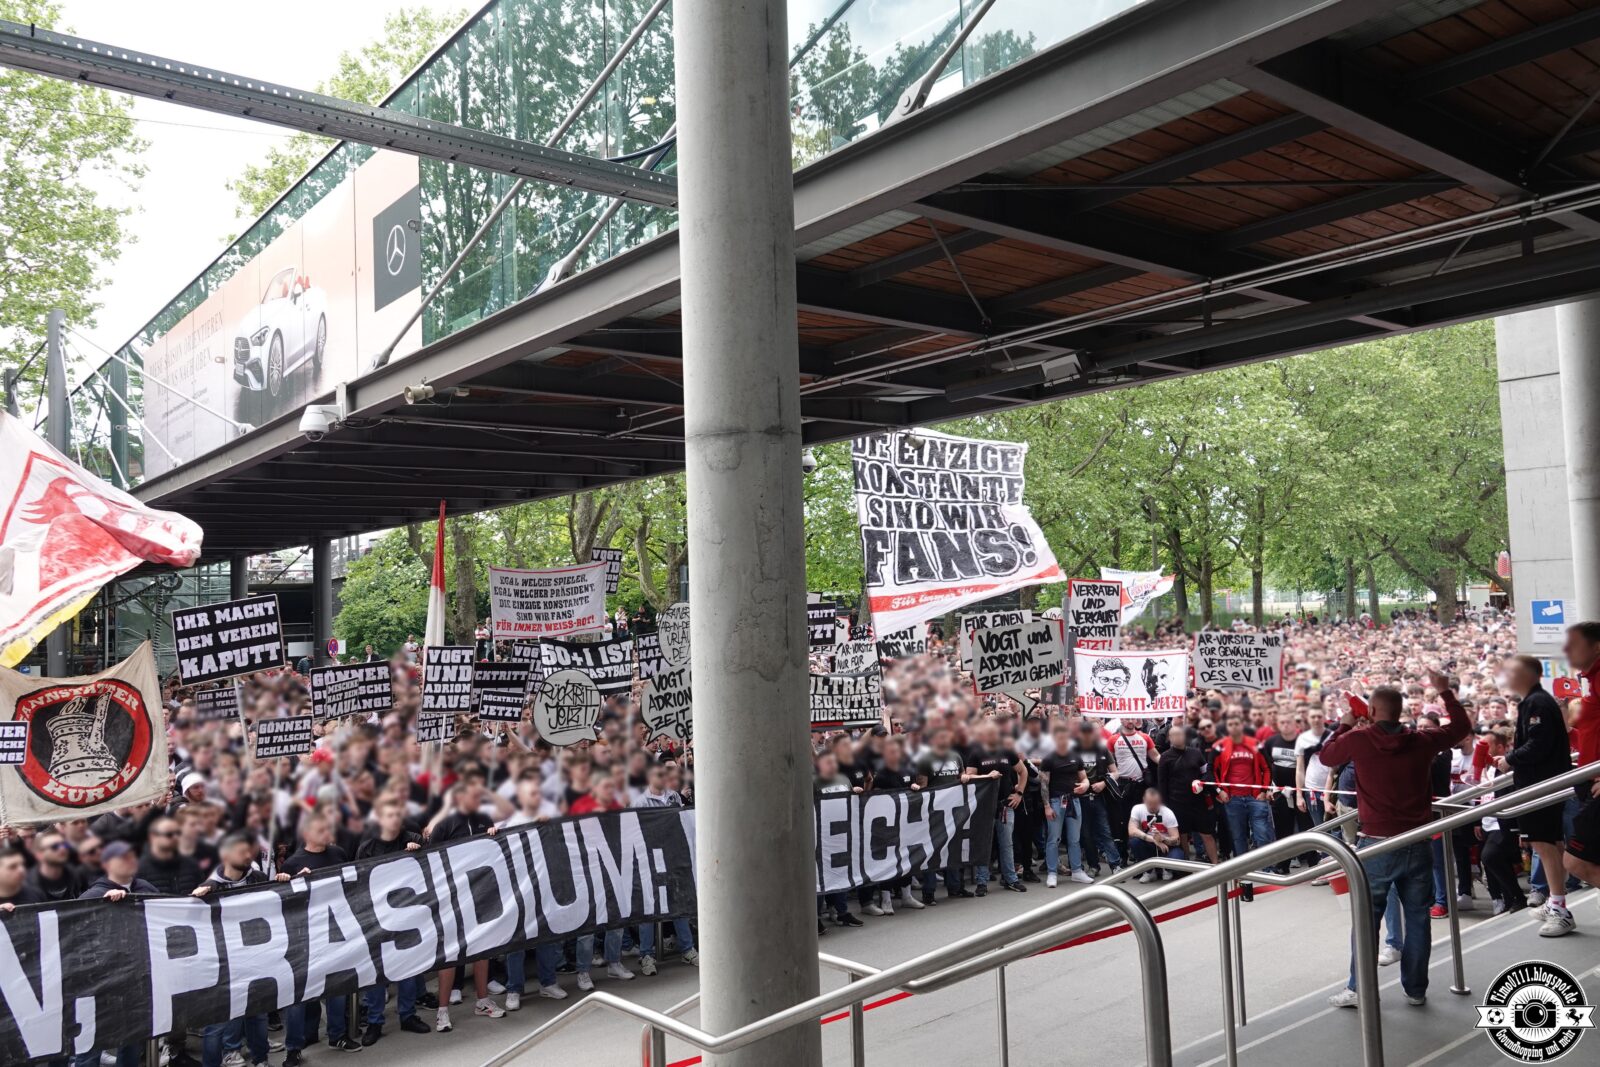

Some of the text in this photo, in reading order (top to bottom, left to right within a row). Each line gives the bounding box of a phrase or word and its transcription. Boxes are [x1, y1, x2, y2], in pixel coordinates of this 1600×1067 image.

[899, 432, 1021, 474] EINZIGE
[855, 458, 1023, 503] KONSTANTE
[868, 497, 1006, 532] SIND WIR
[591, 549, 621, 561] VOGT
[863, 525, 1037, 585] FANS!
[499, 575, 520, 586] EGAL
[521, 578, 552, 588] WELCHE
[493, 586, 512, 598] EGAL
[513, 588, 549, 599] WELCHER
[1072, 583, 1120, 597] VERRATEN
[499, 596, 590, 610] DIE EINZIGE KONSTANTE
[1081, 598, 1106, 610] UND
[175, 600, 276, 632] IHR MACHT
[516, 609, 575, 622] SIND WIR FANS!
[808, 609, 836, 619] TRITT
[1071, 609, 1120, 626] VERKAUFT
[495, 614, 595, 633] FÜR IMMER WEISS-ROT!
[964, 615, 989, 633] FÜR
[991, 611, 1024, 629] EINEN
[177, 621, 279, 652] DEN VEREIN
[977, 624, 1053, 654] VOGT und
[1198, 633, 1281, 648] AR-VORSITZ NUR
[428, 649, 474, 664] VOGT
[514, 645, 540, 658] VOG
[598, 639, 633, 665] IST
[639, 647, 661, 659] HAL
[1199, 645, 1269, 659] FÜR GEWÄHLTE
[180, 641, 281, 679] KAPUTT
[979, 648, 1034, 674] ADRION
[1203, 657, 1265, 669] VERTRETER
[426, 665, 473, 682] UND
[474, 670, 529, 681] CKTRITT
[651, 667, 685, 693] VOGT
[977, 659, 1064, 691] ZEIT ZU GEHN!
[1200, 669, 1228, 683] DES
[358, 682, 391, 695] SCHE
[424, 683, 472, 694] ADRION
[422, 694, 470, 709] RAUS
[483, 694, 524, 704] RÜCKTRITT
[1078, 692, 1147, 712] RÜCKTRITT
[326, 698, 358, 718] MAUL
[480, 704, 522, 717] JETZT
[651, 706, 690, 731] ZEIT
[259, 719, 312, 734] GÖNNER
[675, 719, 693, 744] GE
[257, 732, 311, 745] DU FALSCHE
[256, 743, 310, 757] SCHLANGE
[43, 761, 138, 804] KURVE
[144, 811, 671, 1038] PRÄSIDIUM:
[814, 783, 977, 893] EICHT!
